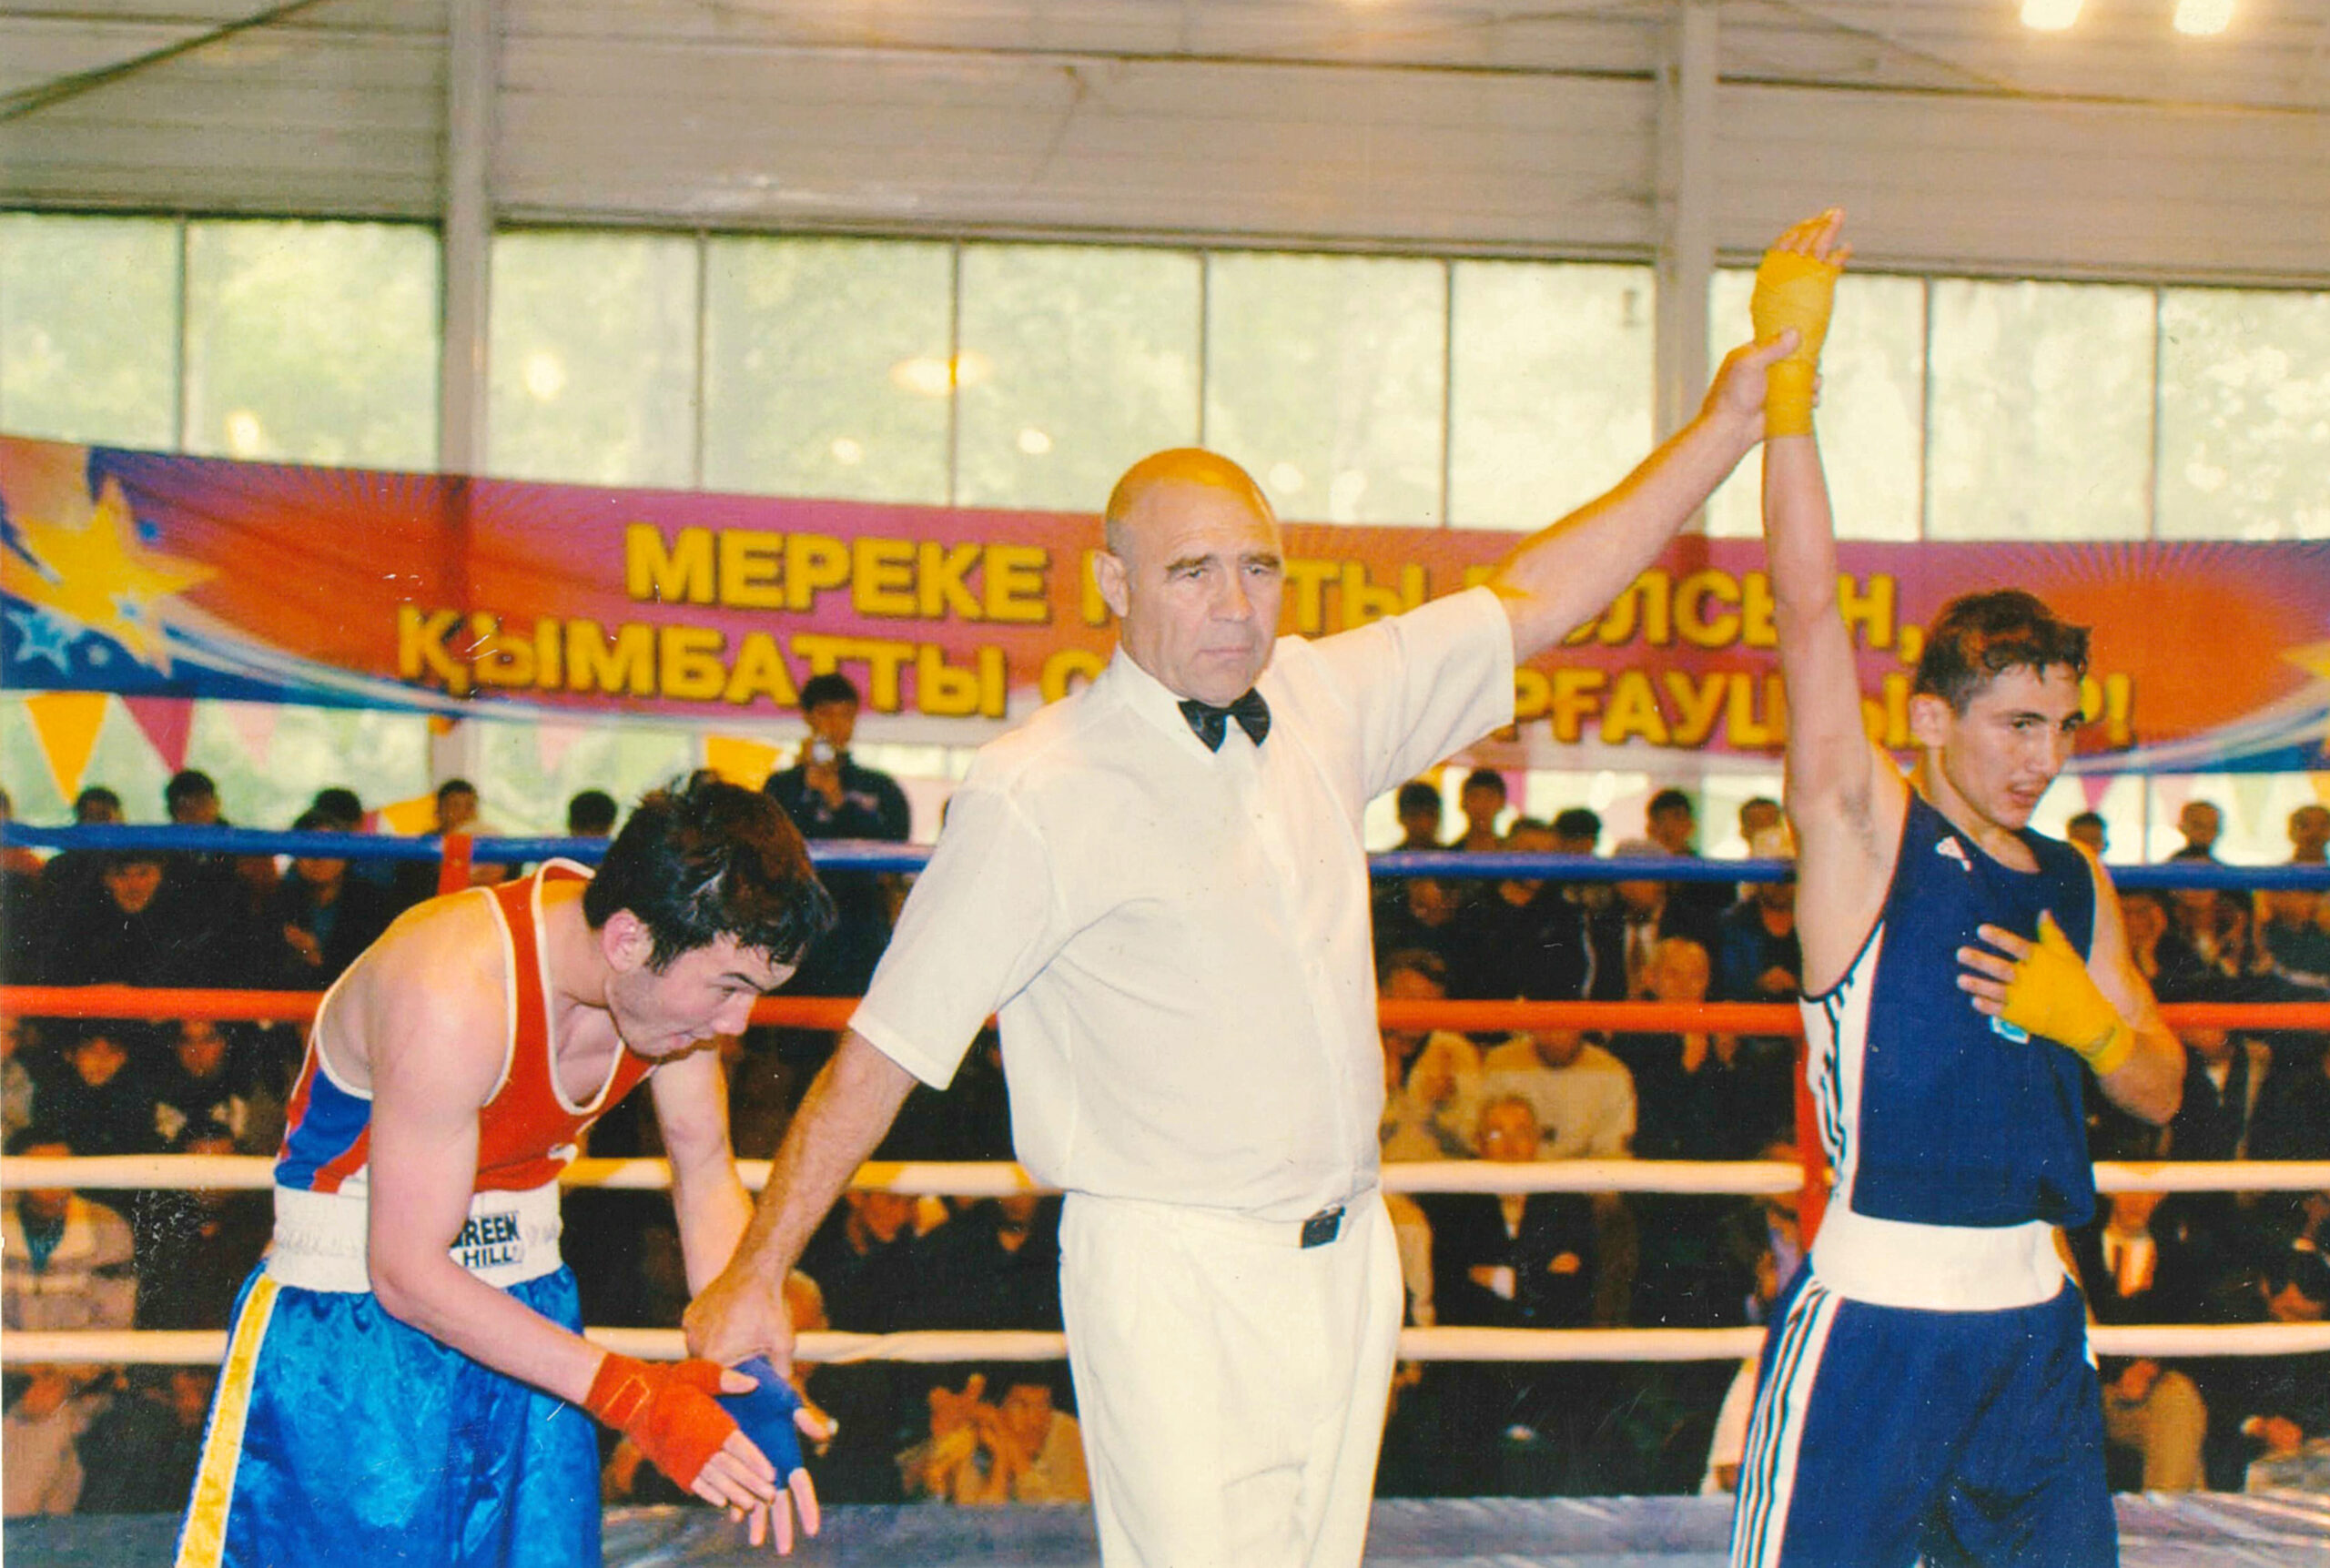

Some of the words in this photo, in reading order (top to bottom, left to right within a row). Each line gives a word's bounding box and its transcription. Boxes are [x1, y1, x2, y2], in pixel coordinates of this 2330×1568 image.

[624, 521, 1048, 622] МЕРЕКЕ
[397, 604, 1008, 718] ҚЫМБАТТЫ
[462, 1246, 513, 1268] HILL
